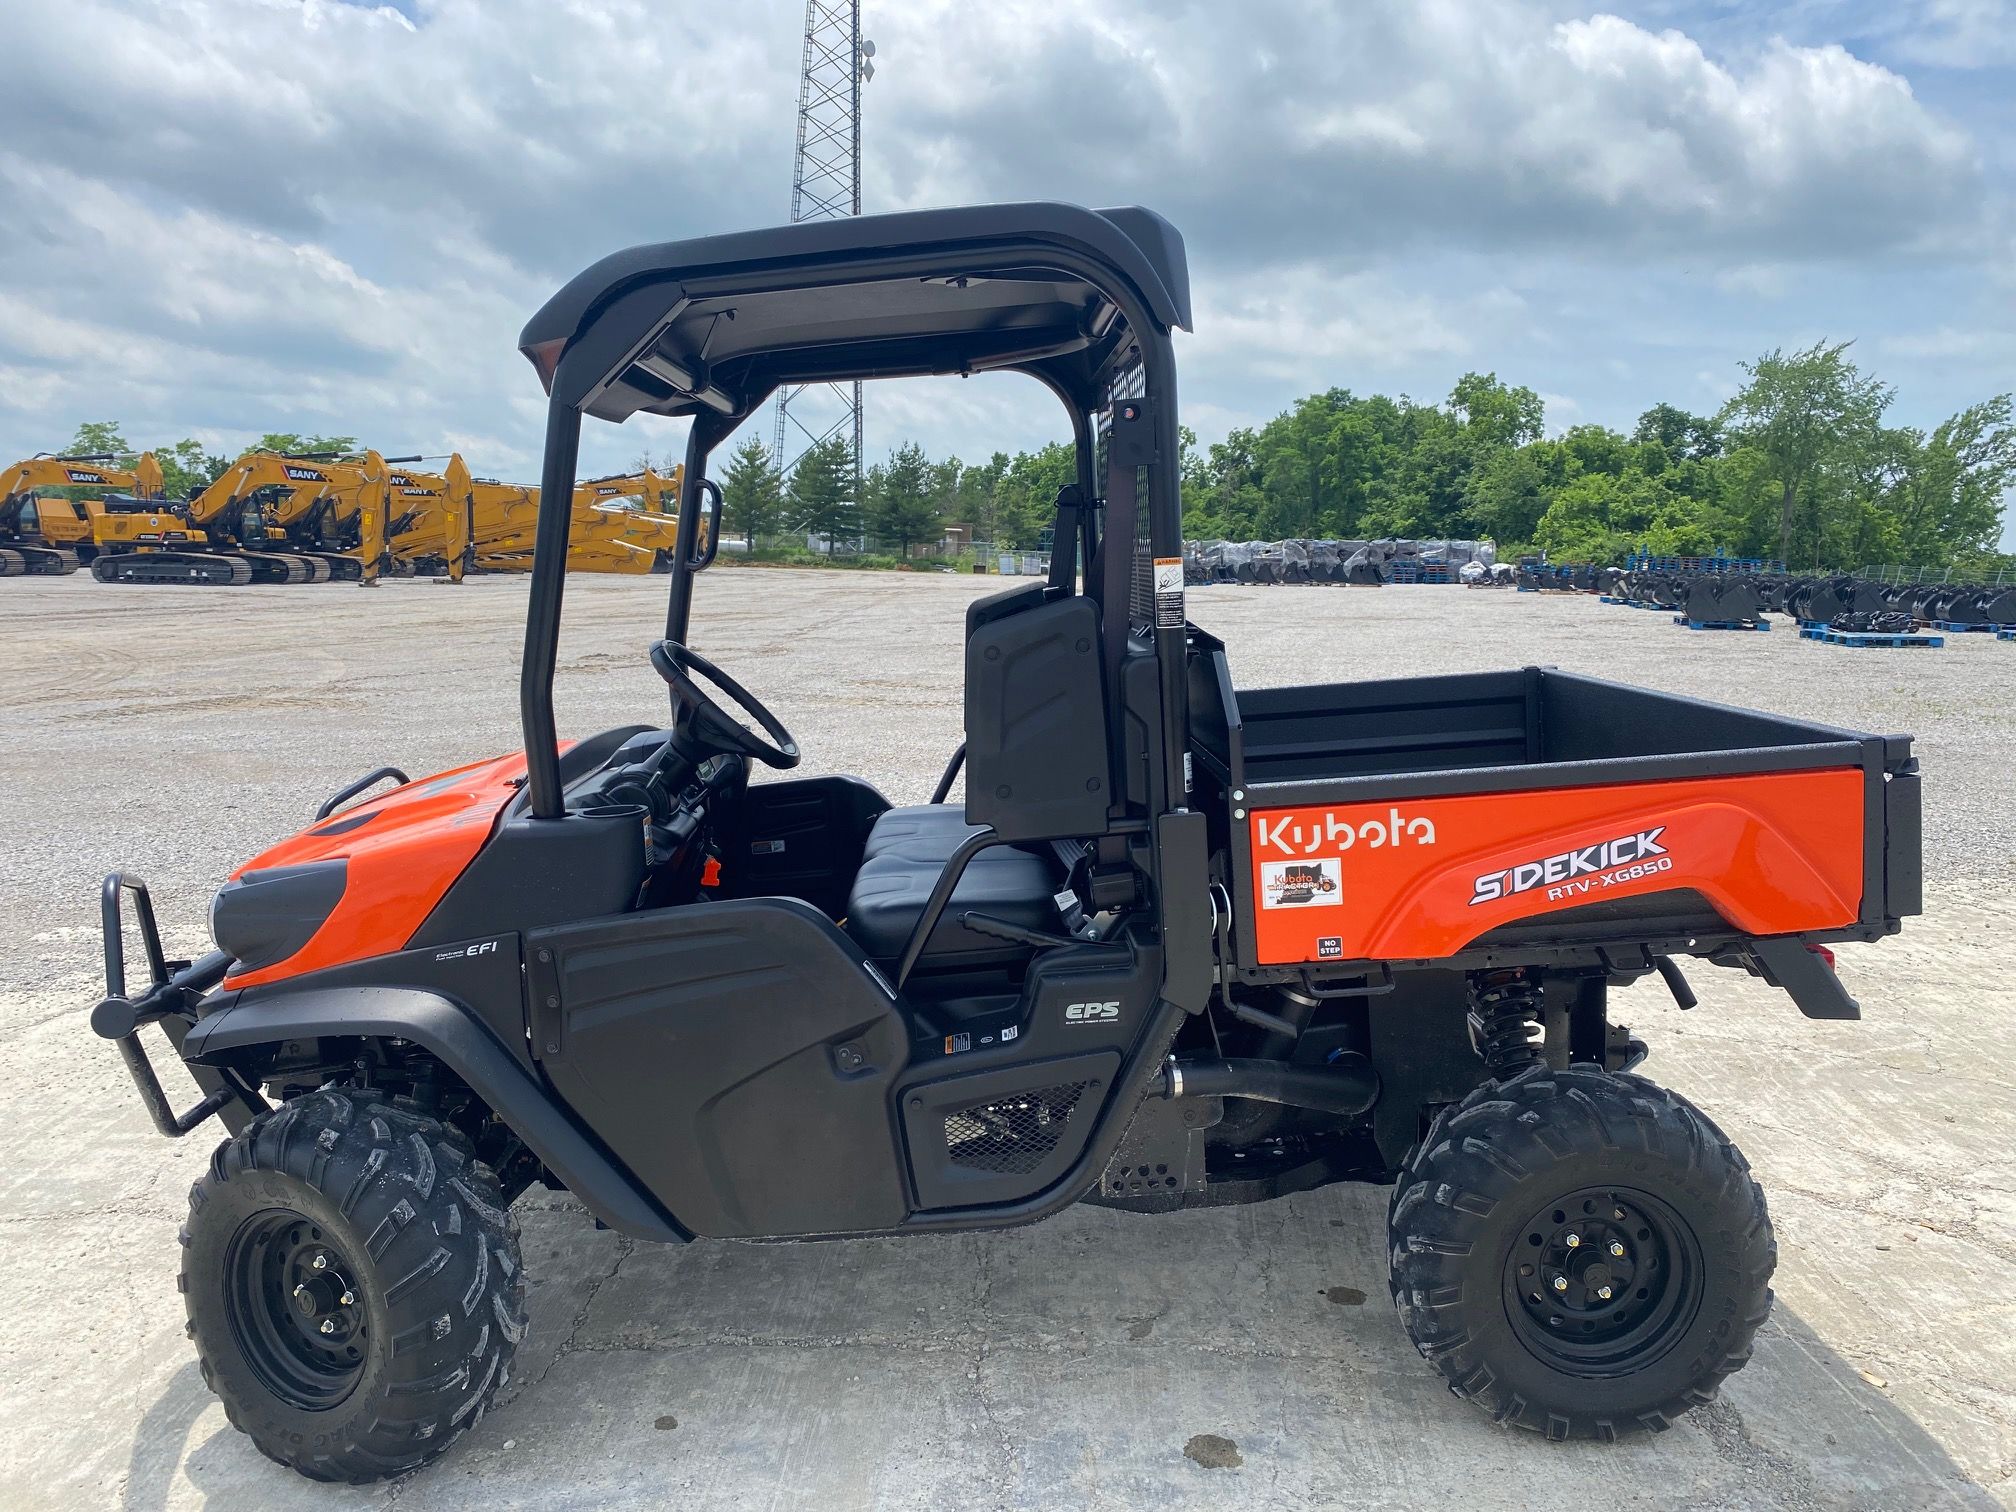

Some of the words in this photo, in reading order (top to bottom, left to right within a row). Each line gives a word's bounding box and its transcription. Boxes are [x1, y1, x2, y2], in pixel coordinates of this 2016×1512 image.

[71, 473, 99, 482] SANY
[289, 469, 318, 480] SANY
[391, 476, 406, 485] NY
[1258, 808, 1436, 855] Kubota
[1468, 826, 1670, 906] SIDEKICK
[1274, 873, 1313, 884] Kubota
[1547, 857, 1673, 902] RTV-XG850
[466, 941, 498, 956] EFI
[1324, 939, 1336, 947] NO
[1320, 947, 1340, 955] STEP
[1065, 1001, 1120, 1019] EPS
